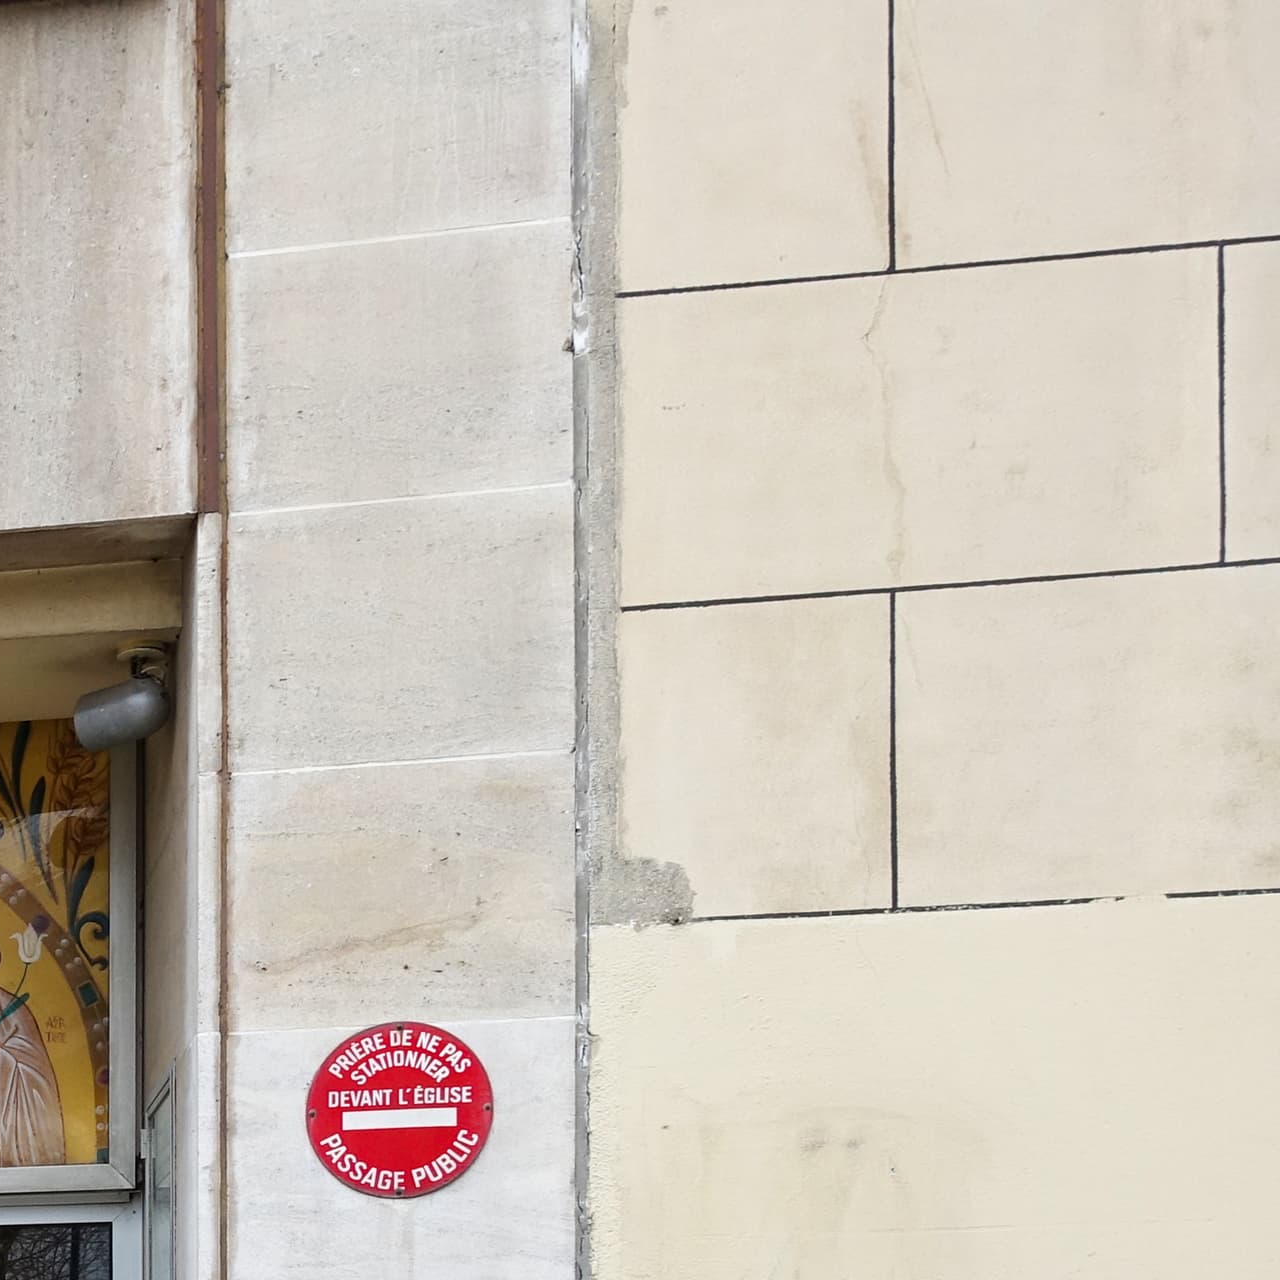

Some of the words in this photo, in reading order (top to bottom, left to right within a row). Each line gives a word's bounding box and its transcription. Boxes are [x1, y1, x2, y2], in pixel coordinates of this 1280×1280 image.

[328, 1032, 386, 1079] PRIÈRE
[390, 1029, 414, 1047] DE
[416, 1031, 442, 1053] NE
[439, 1042, 472, 1074] PAS
[350, 1050, 450, 1086] STATIONNER
[328, 1089, 392, 1108] DEVANT
[398, 1085, 473, 1105] L'ÉGLISE
[320, 1133, 405, 1190] PASSAGE
[411, 1129, 479, 1188] PUBLIC
